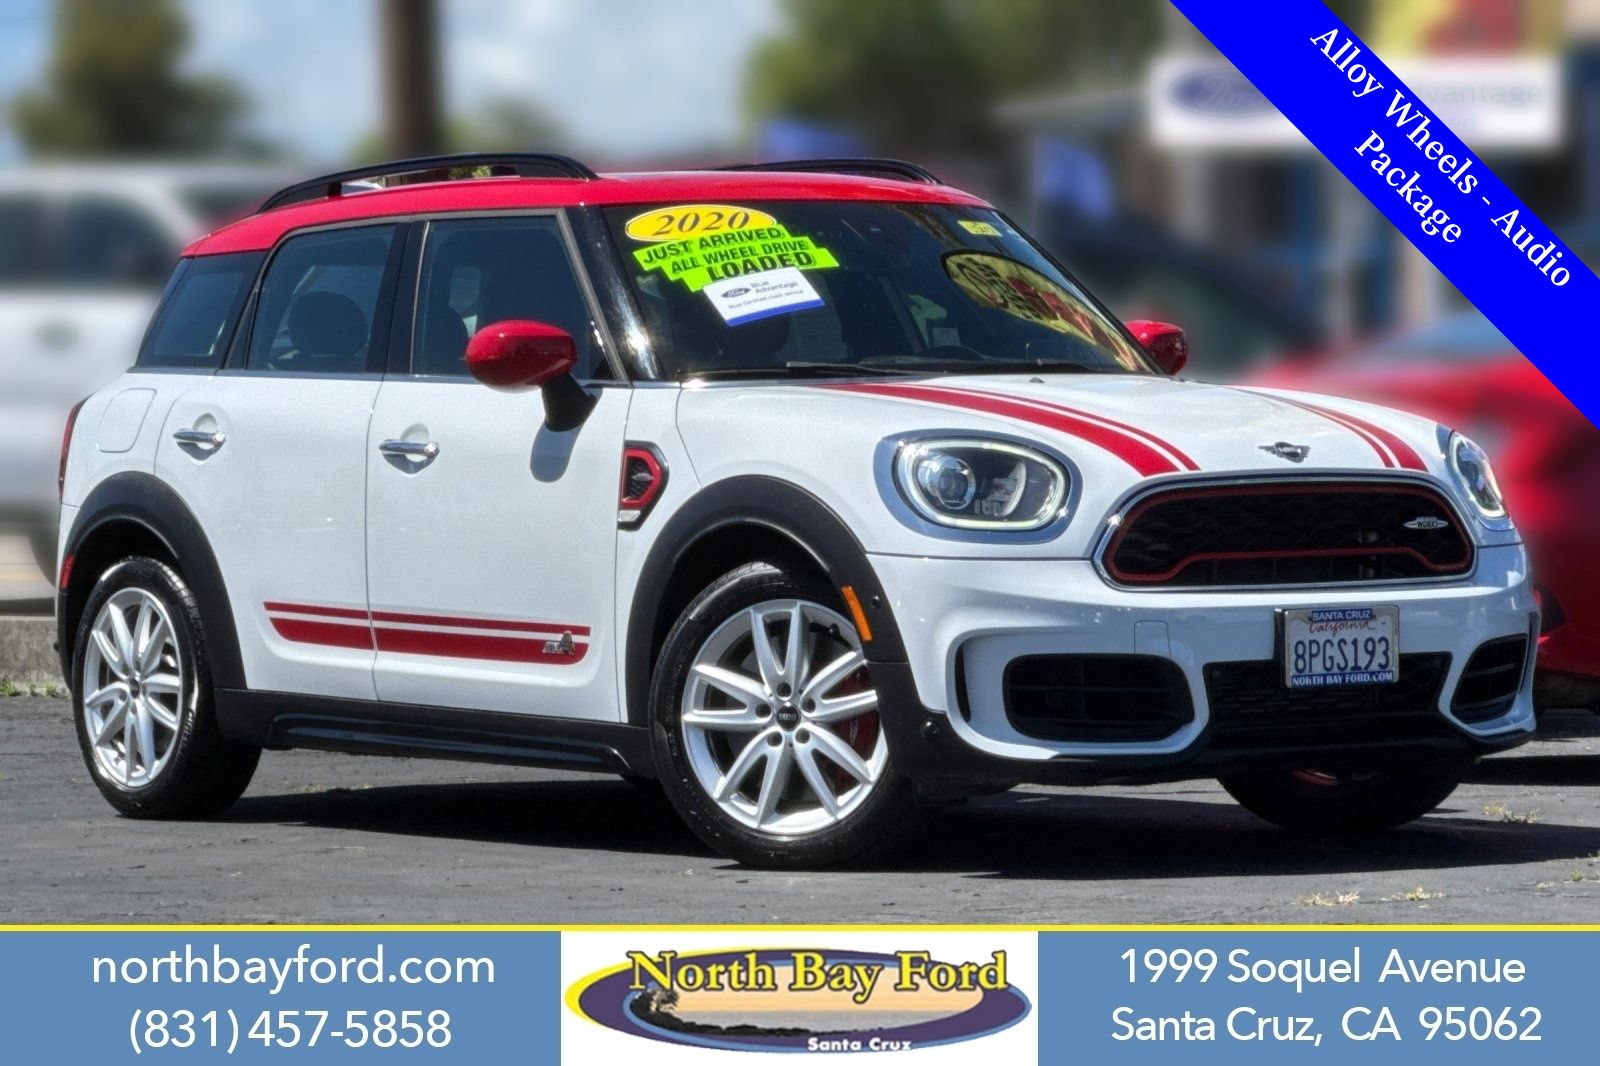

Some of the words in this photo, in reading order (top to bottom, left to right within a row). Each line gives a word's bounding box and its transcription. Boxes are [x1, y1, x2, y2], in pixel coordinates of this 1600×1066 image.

[652, 211, 751, 236] 2020
[643, 240, 692, 264] JUST
[699, 227, 782, 250] ARRIVED
[671, 258, 700, 274] ALL
[703, 247, 757, 265] WHEEL
[761, 240, 808, 255] DRIVE
[706, 251, 814, 282] LOADED
[755, 281, 798, 293] Advantage
[1312, 610, 1344, 621] SANTA
[1345, 609, 1371, 619] CRUZ
[1309, 620, 1376, 637] California
[1294, 636, 1390, 674] 8PGS193
[1292, 676, 1324, 686] NORTH
[1326, 674, 1342, 684] BAY
[1345, 672, 1392, 683] FORD.COM
